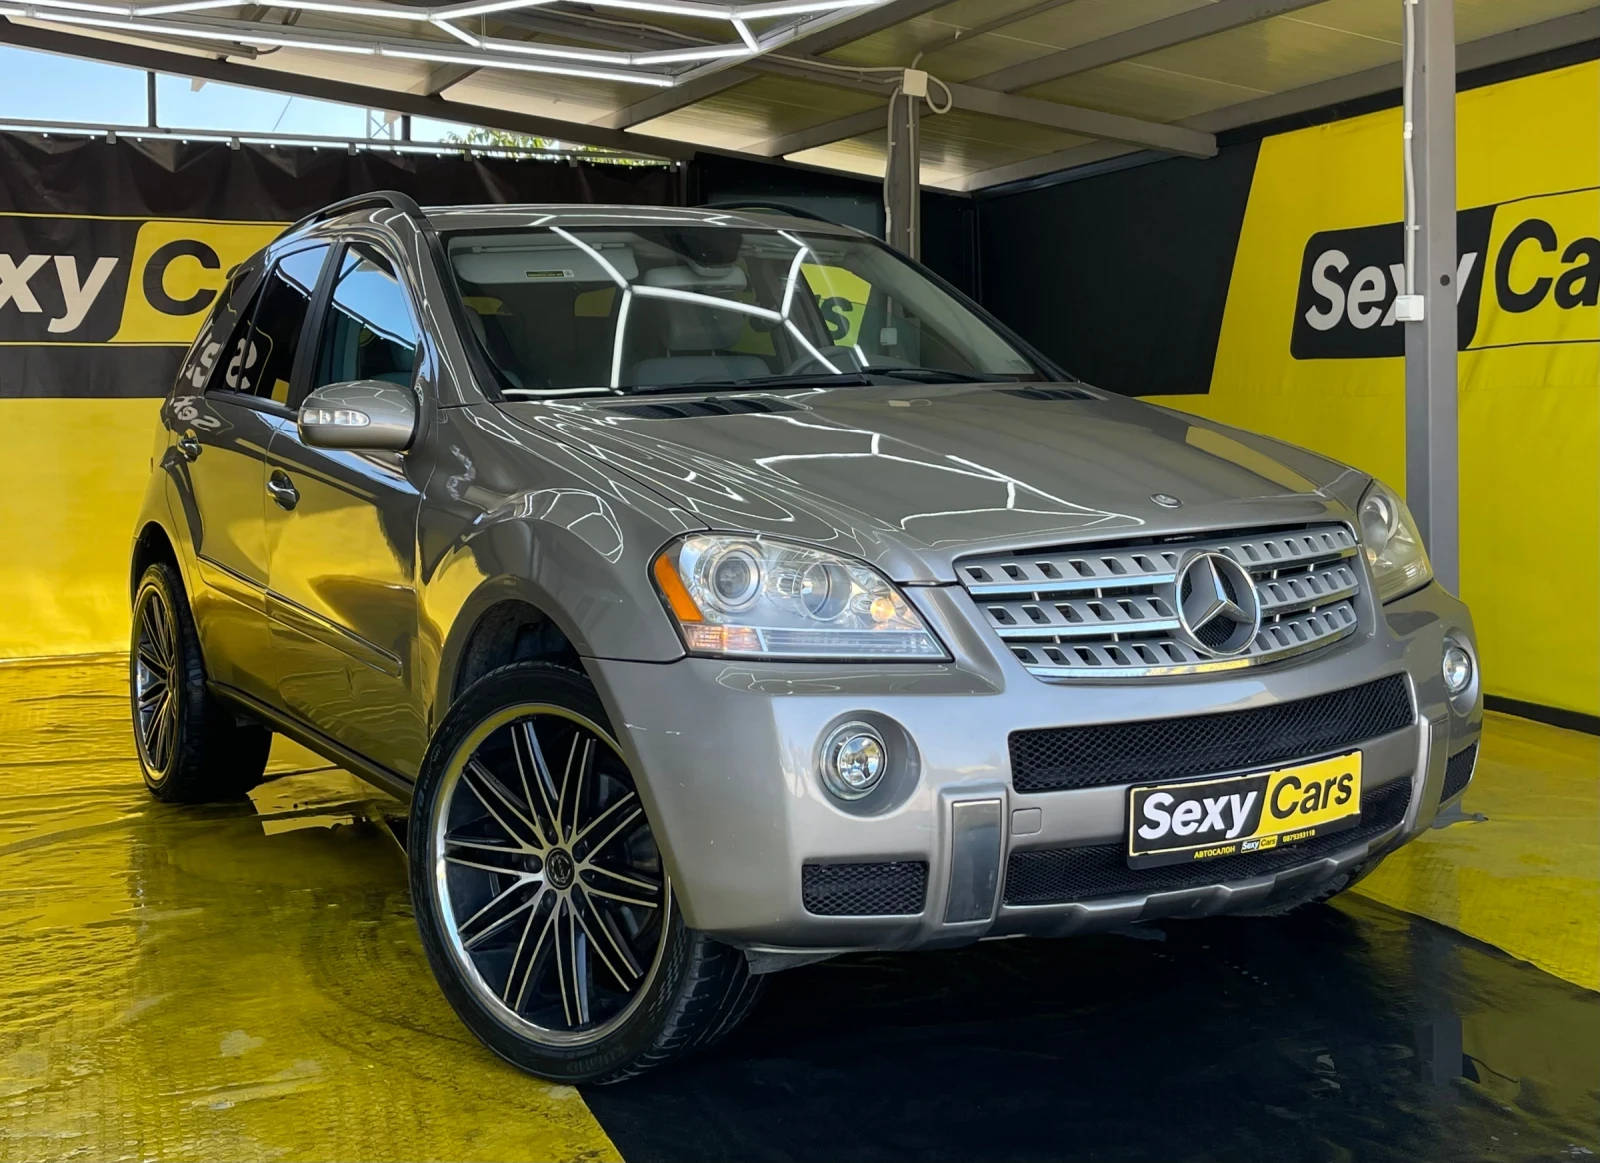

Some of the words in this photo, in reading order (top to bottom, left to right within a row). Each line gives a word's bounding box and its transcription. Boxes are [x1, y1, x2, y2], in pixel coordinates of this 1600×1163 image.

[1138, 791, 1258, 839] Sexy
[1270, 773, 1353, 820] Cars
[1194, 846, 1236, 859] АВТОСАЛОН
[1242, 841, 1260, 850] Sexy
[1261, 838, 1275, 847] Cars
